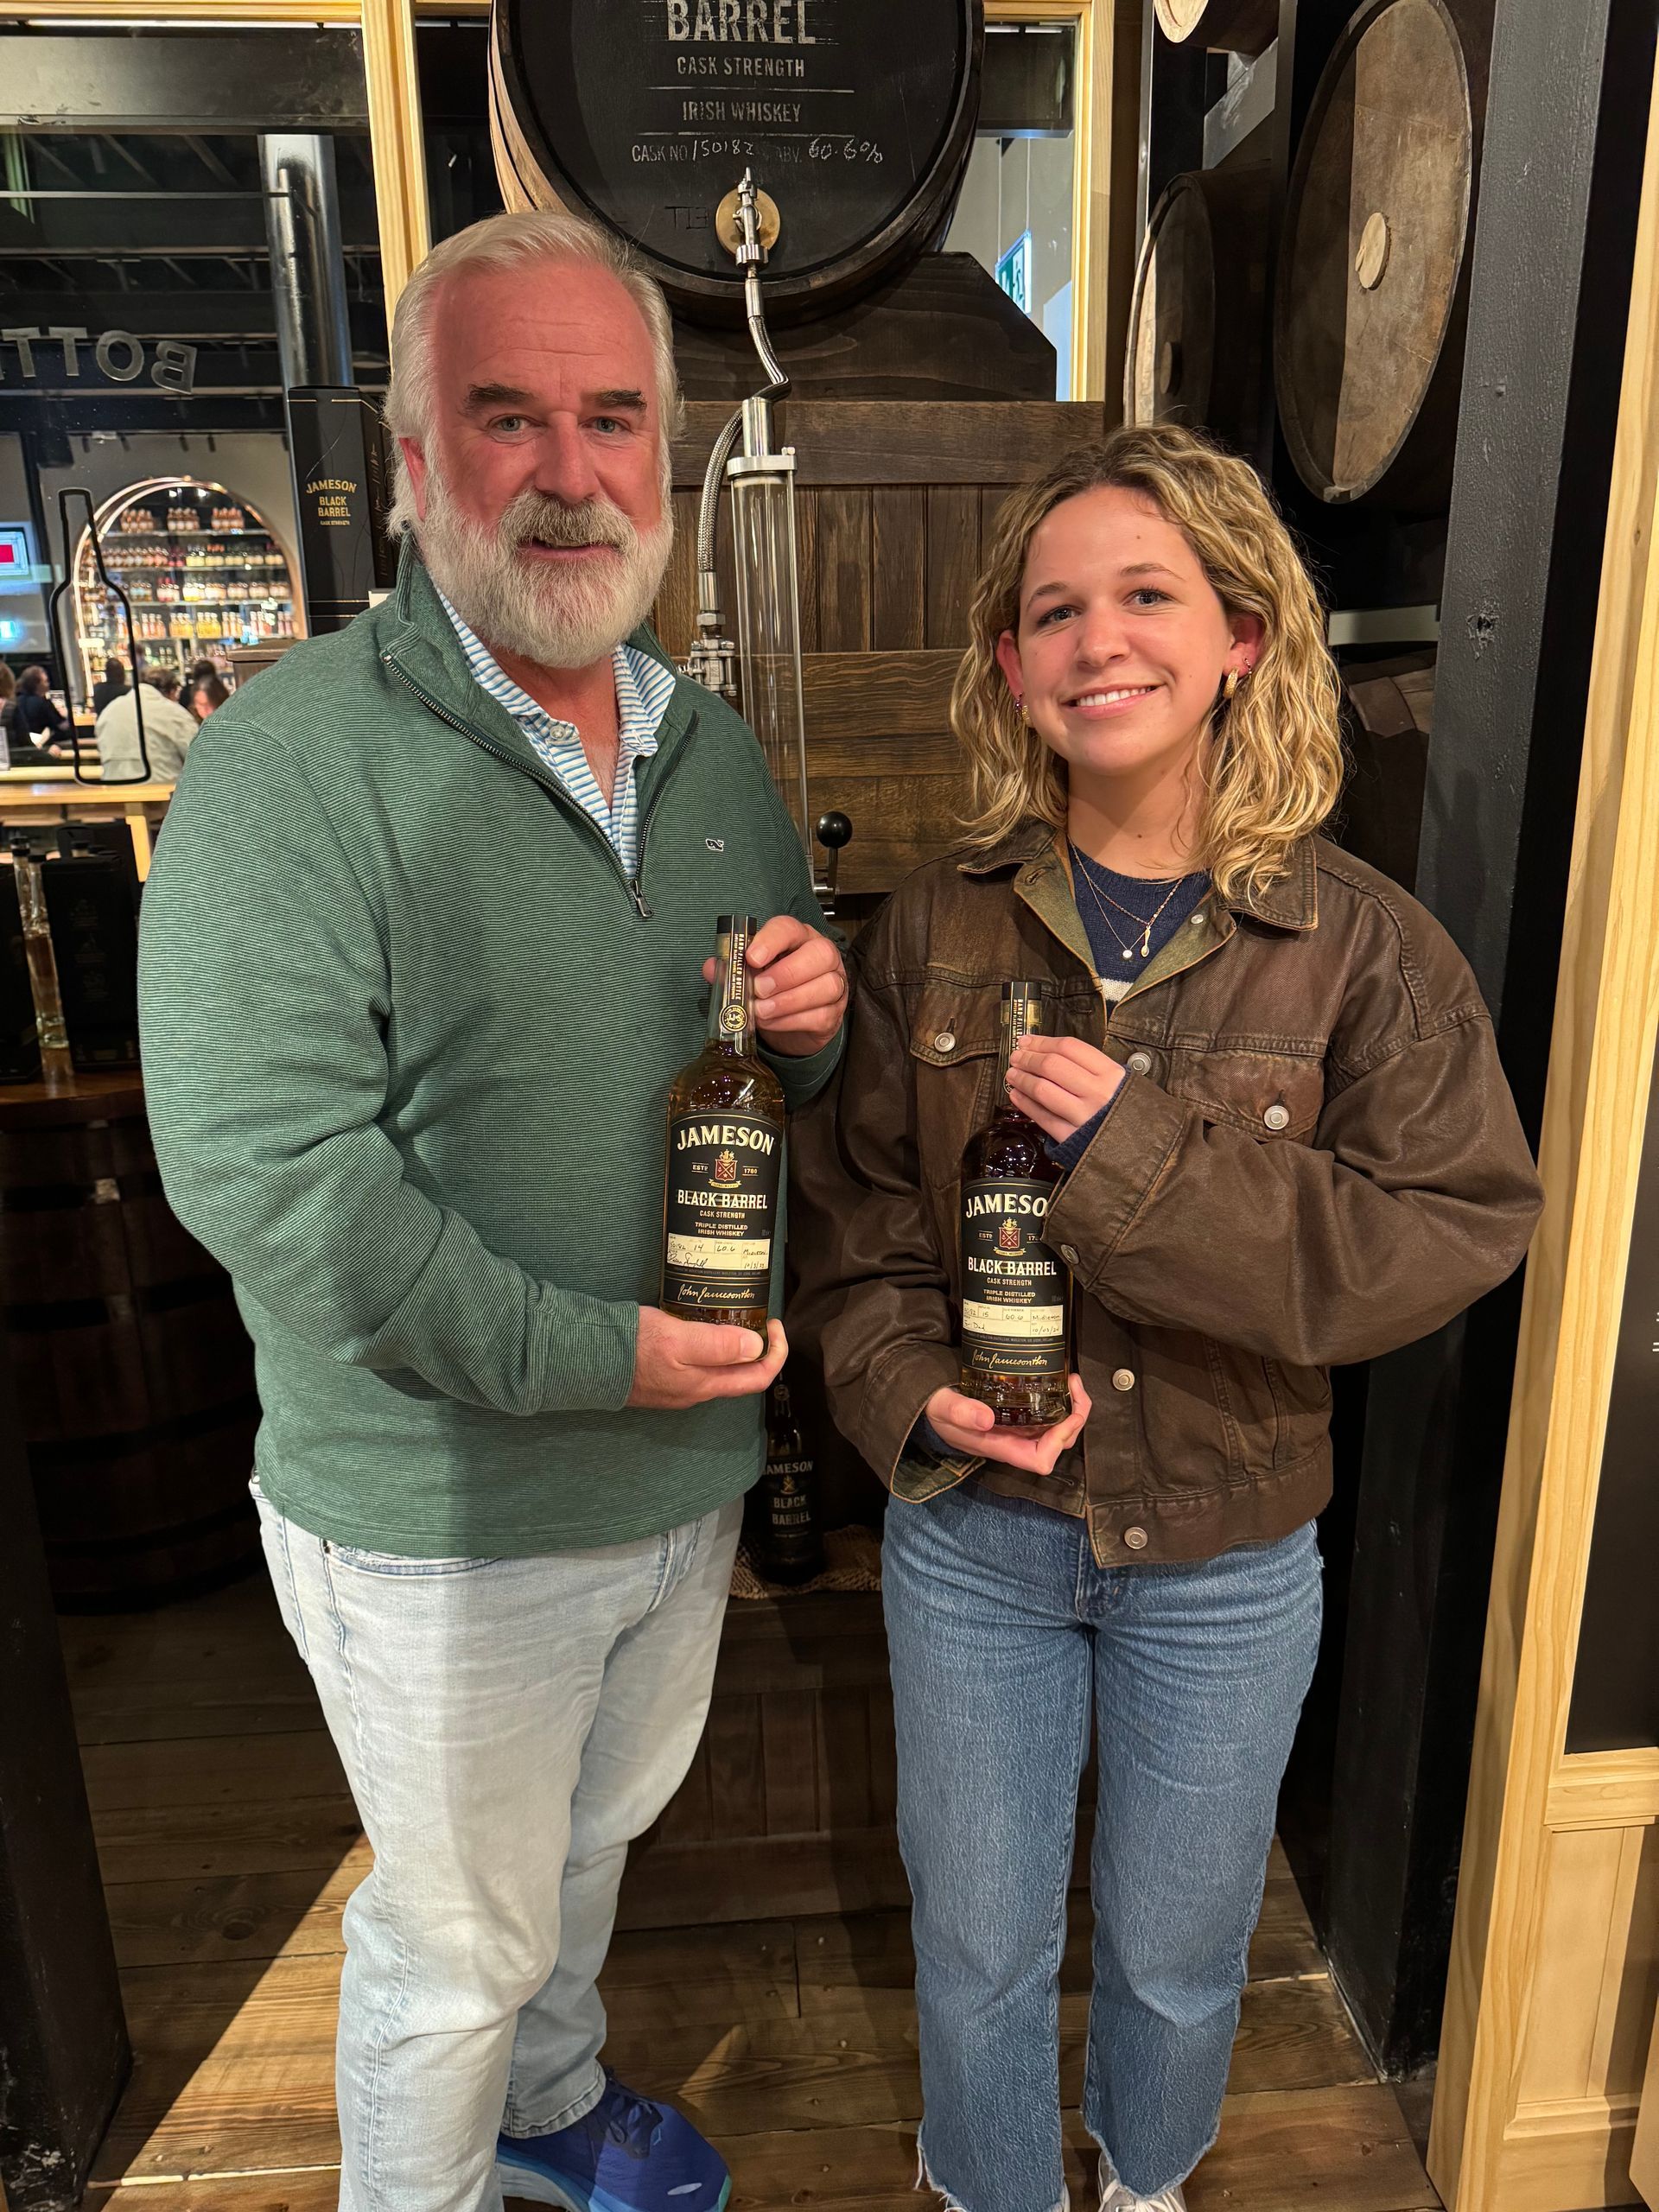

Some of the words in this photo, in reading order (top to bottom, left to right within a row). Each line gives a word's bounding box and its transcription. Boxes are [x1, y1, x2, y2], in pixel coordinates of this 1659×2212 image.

[667, 0, 816, 43] BARREL
[677, 56, 717, 75] CASK
[724, 57, 804, 78] STRENGTH
[683, 101, 726, 121] IRISH
[732, 102, 801, 123] WHISKEY
[632, 144, 666, 162] CASK
[670, 146, 688, 162] NO
[306, 480, 357, 493] JAMESON
[319, 496, 347, 505] BLACK
[318, 507, 351, 517] BARREL
[677, 1125, 774, 1155] JAMESON
[677, 1189, 716, 1207] BLACK
[722, 1193, 767, 1209] BARREL
[966, 1194, 1048, 1217] JAMESO
[716, 1211, 745, 1219] STRENGTH
[969, 1256, 1002, 1274] BLACK
[1007, 1262, 1057, 1275] BARREL
[677, 1284, 698, 1301] John
[972, 1349, 989, 1365] John
[773, 1495, 806, 1509] BLACK
[772, 1510, 811, 1525] BARREL
